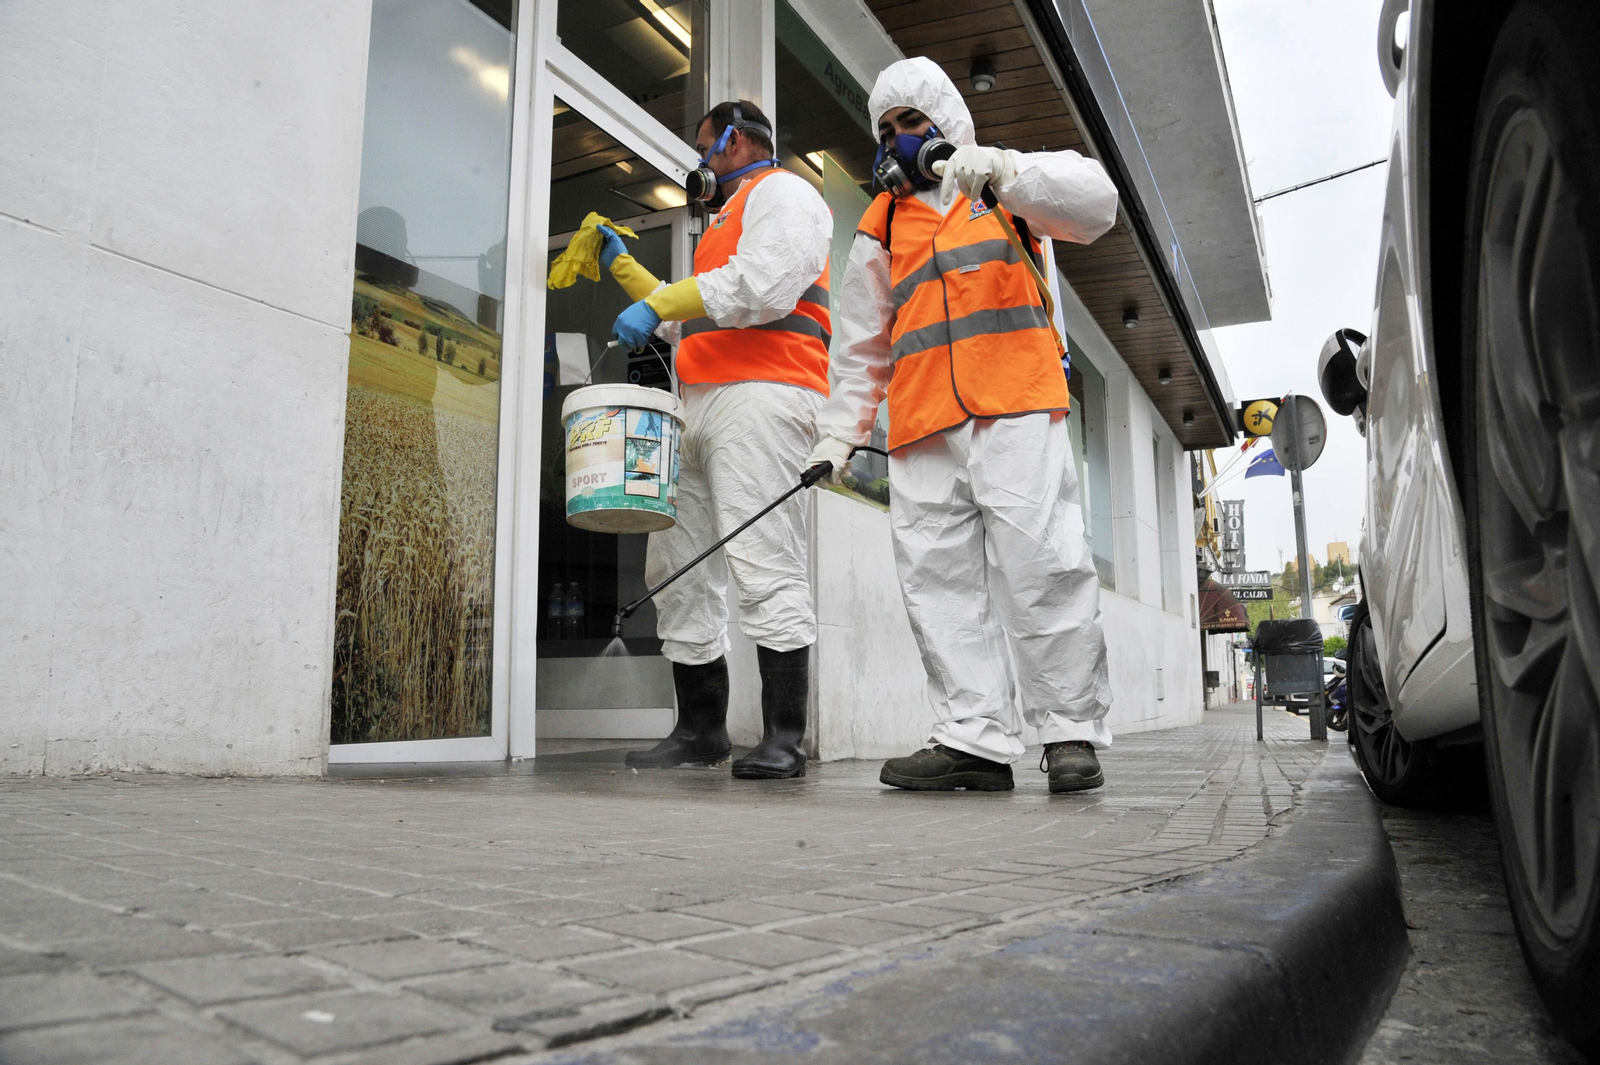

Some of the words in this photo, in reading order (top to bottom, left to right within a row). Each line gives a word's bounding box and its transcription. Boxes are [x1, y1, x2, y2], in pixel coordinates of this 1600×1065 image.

[824, 61, 871, 123] AgroBa
[572, 472, 607, 489] SPORT
[1228, 503, 1241, 568] HOTEL
[1223, 574, 1234, 584] LA
[1238, 573, 1268, 584] FONDA
